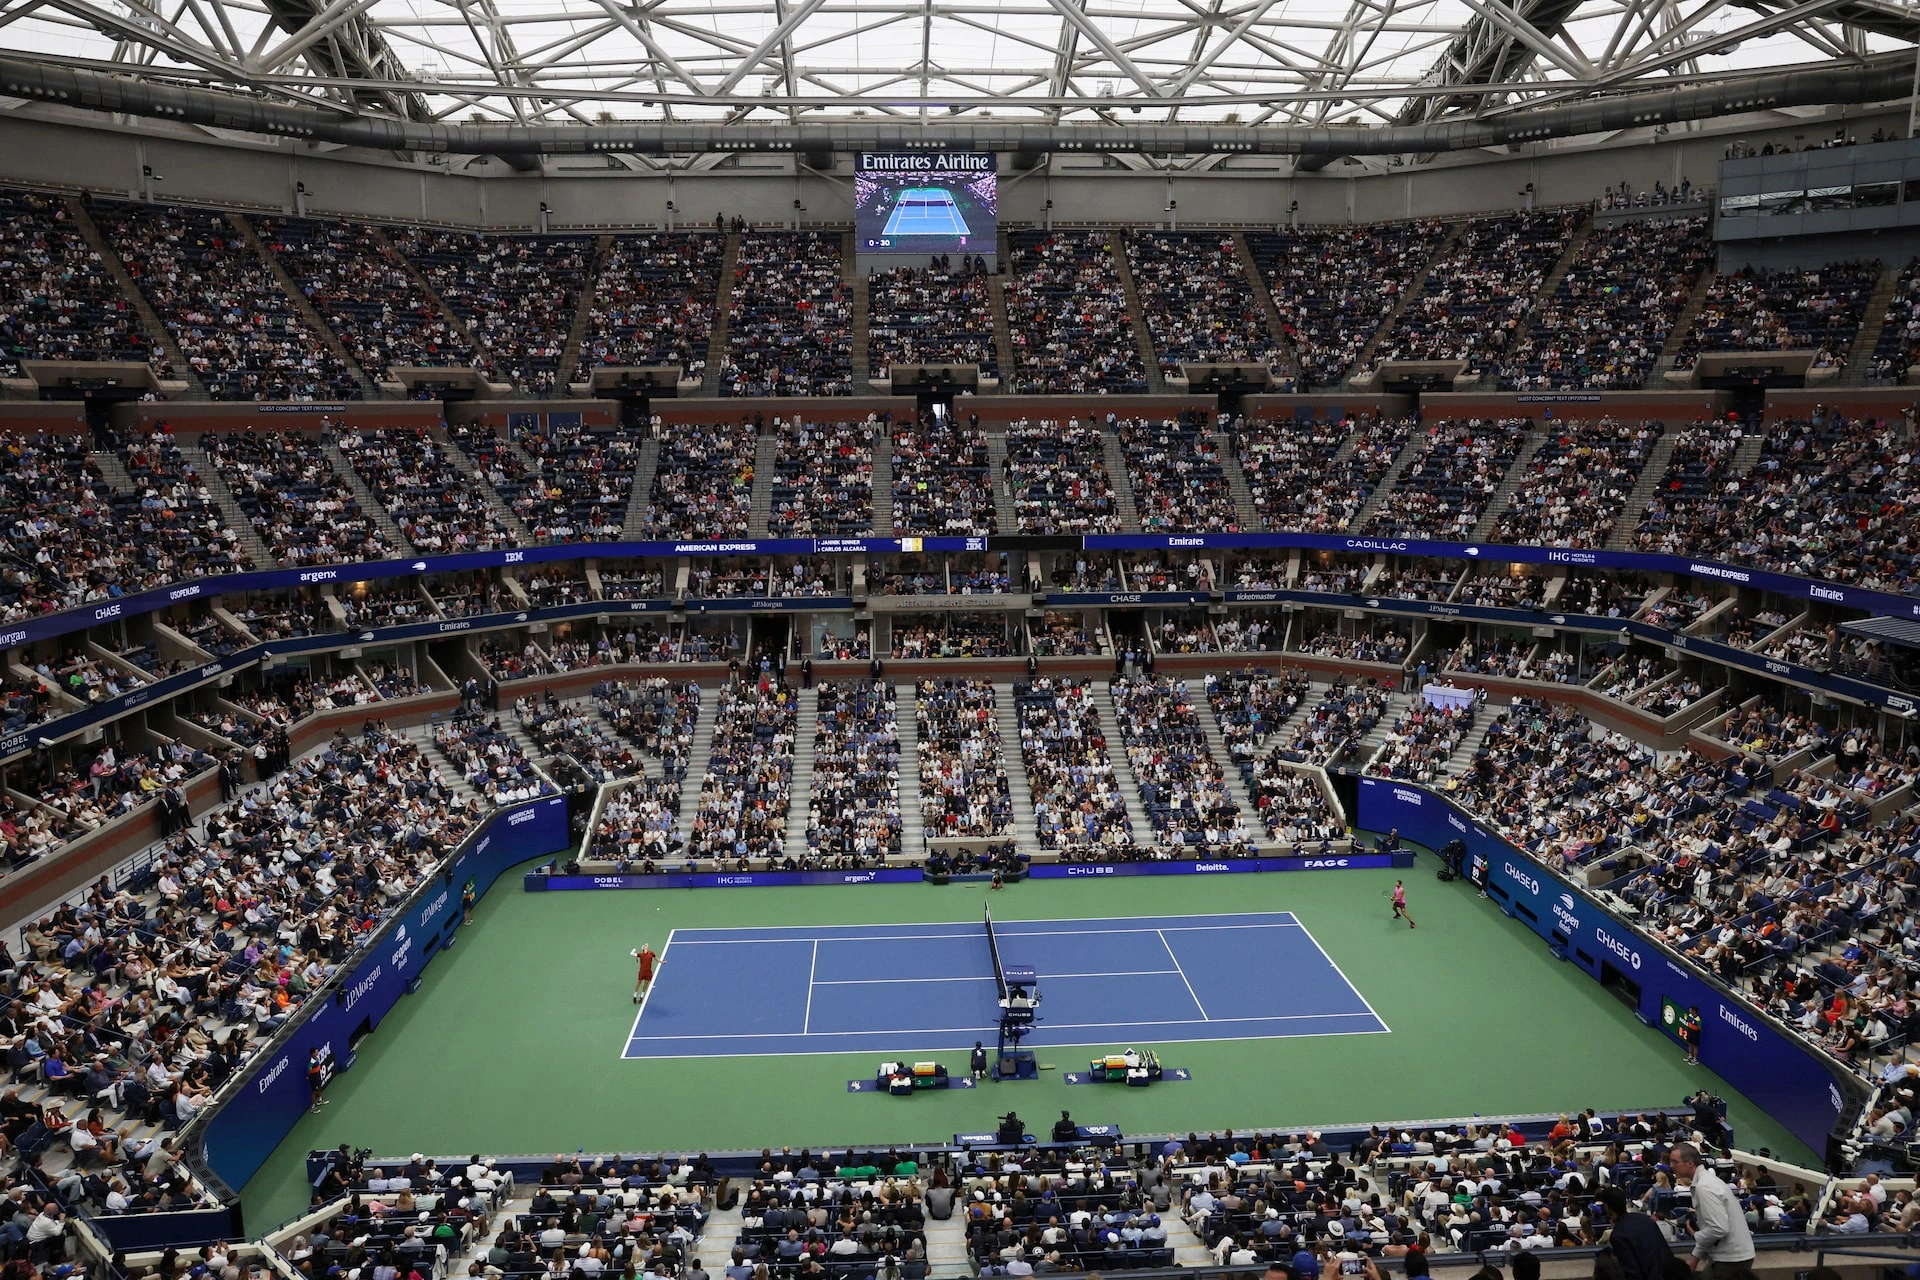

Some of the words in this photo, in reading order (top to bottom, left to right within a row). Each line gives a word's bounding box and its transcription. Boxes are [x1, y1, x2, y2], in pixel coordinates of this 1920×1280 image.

[863, 154, 931, 170] Emirates
[935, 154, 989, 170] Airline
[675, 544, 717, 552] AMERICAN
[1169, 537, 1204, 546] Emirates
[1347, 540, 1406, 550] CADILLAC
[505, 551, 523, 562] IBM
[1549, 552, 1569, 561] IHG
[301, 571, 336, 582] argenx
[1690, 564, 1720, 576] AMERICAN
[1721, 570, 1749, 582] EXPRESS
[1237, 593, 1276, 601] ticketmaster
[1810, 585, 1844, 601] Emirates
[95, 605, 121, 620] CHASE
[440, 621, 470, 631] Emirates
[1673, 634, 1687, 647] IBM
[1766, 661, 1790, 674] argenx
[1887, 695, 1913, 710] ESPN
[1, 734, 29, 750] DOBEL
[1393, 788, 1421, 799] AMERICAN
[1397, 795, 1421, 805] EXPRESS
[508, 808, 534, 822] AMERICAN
[511, 814, 535, 826] EXPRESS
[1196, 864, 1229, 872] Deloitte.
[1304, 859, 1349, 867] FAGE
[1068, 867, 1114, 875] CHUBB
[1504, 861, 1531, 889] CHASE
[845, 875, 870, 883] argenx
[1561, 910, 1579, 929] open
[1559, 919, 1571, 935] finals
[398, 937, 412, 959] open
[1596, 927, 1630, 962] CHASE
[1719, 1004, 1758, 1041] Emirates
[259, 1055, 289, 1094] Emirates
